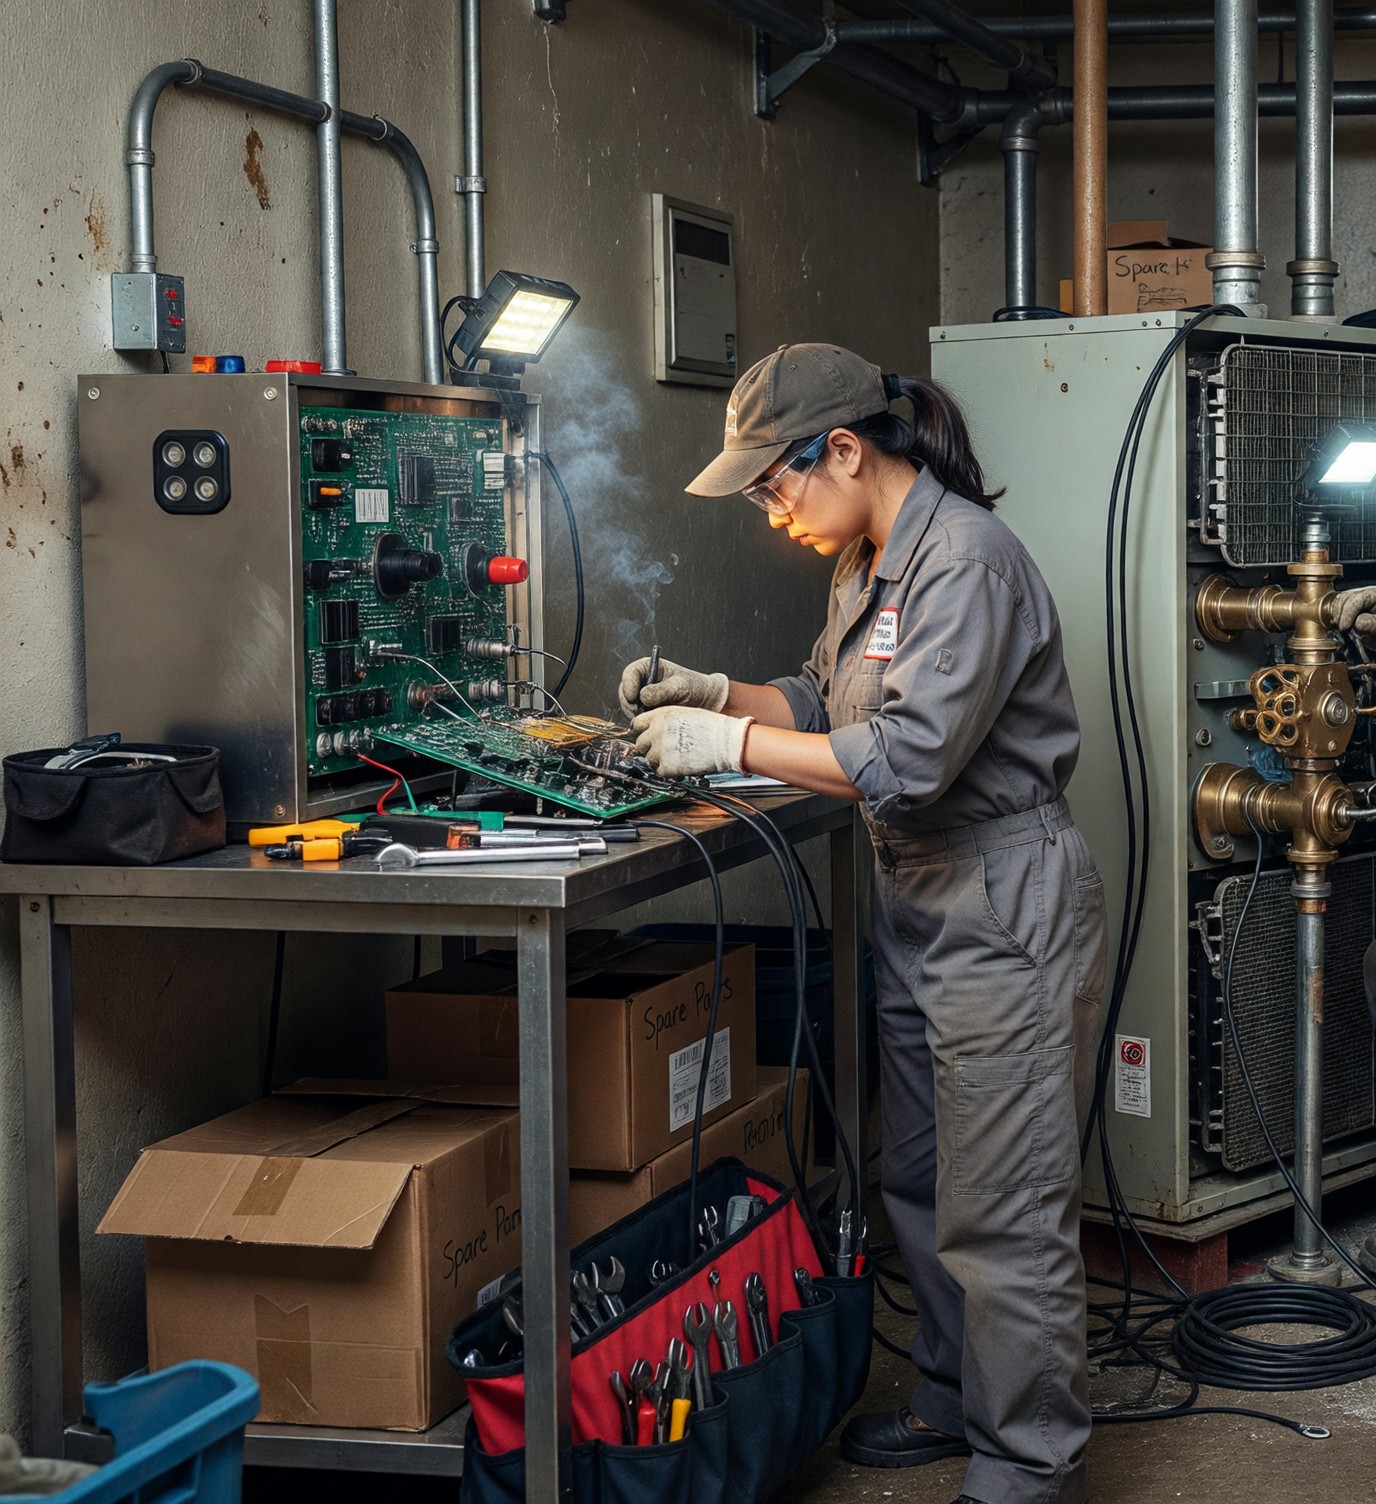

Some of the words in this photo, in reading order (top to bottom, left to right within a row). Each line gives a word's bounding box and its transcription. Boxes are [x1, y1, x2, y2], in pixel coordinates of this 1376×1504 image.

[1115, 255, 1169, 282] Spare
[644, 1003, 686, 1050] Spare
[695, 977, 733, 1017] Pas
[443, 1230, 488, 1288] Spare
